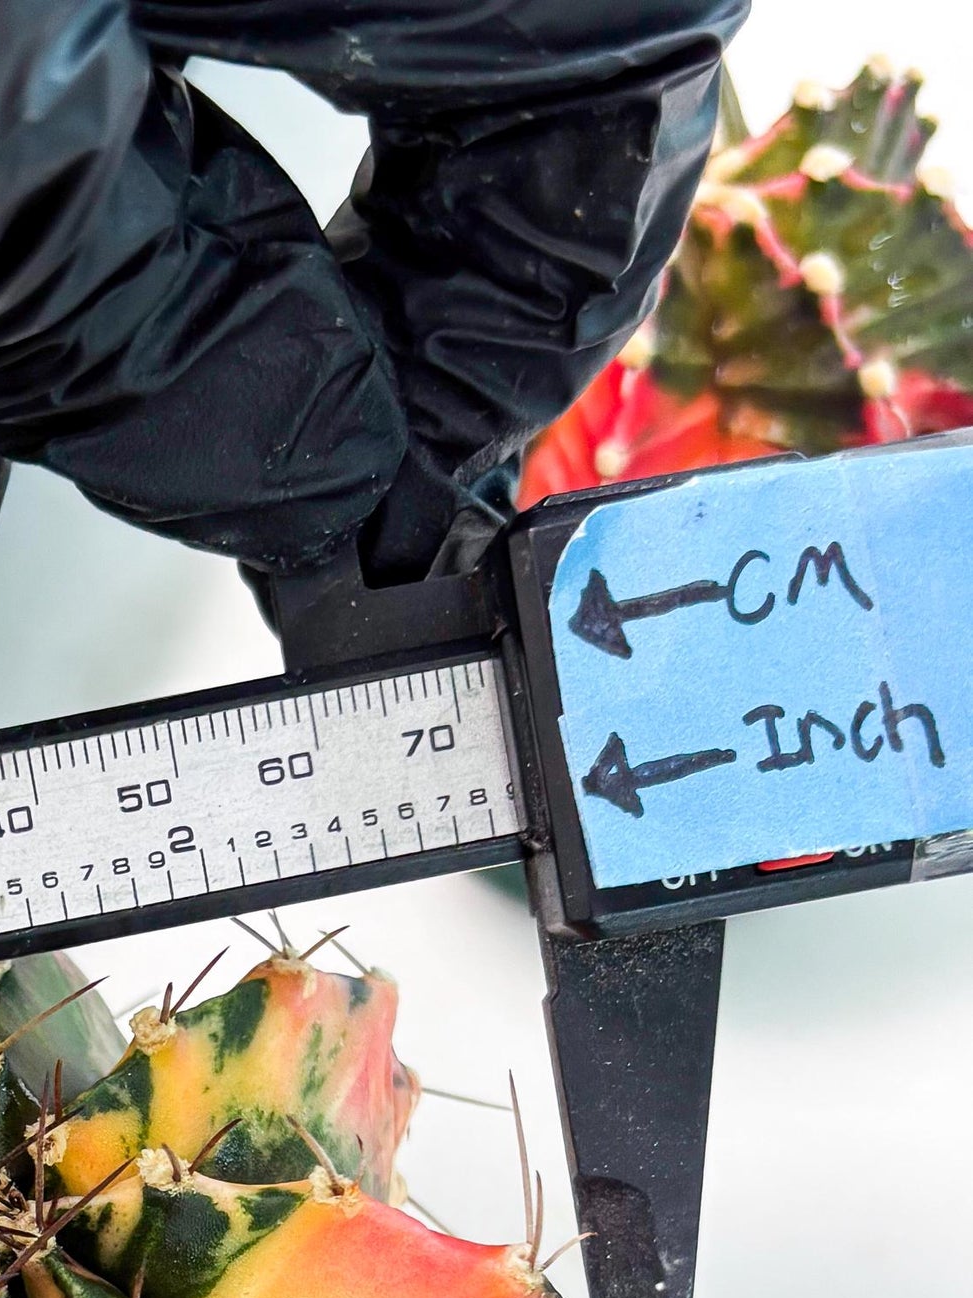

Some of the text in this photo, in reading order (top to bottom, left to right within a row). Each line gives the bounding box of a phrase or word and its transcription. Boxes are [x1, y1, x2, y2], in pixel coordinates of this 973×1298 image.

[116, 778, 173, 814] 50
[257, 751, 315, 787] 60
[400, 724, 456, 758] 70
[742, 680, 946, 773] Inch
[5, 877, 24, 896] 5
[41, 870, 59, 889] 6
[79, 863, 95, 882] 7
[111, 857, 131, 876] 8
[147, 850, 166, 870] 9
[167, 825, 197, 854] 2
[226, 836, 236, 853] 1
[254, 830, 274, 849] 2
[290, 822, 309, 841] 3
[326, 815, 343, 833] 4
[361, 808, 379, 828] 5
[397, 801, 416, 821] 6
[435, 794, 451, 813] 7
[468, 787, 489, 807] 8
